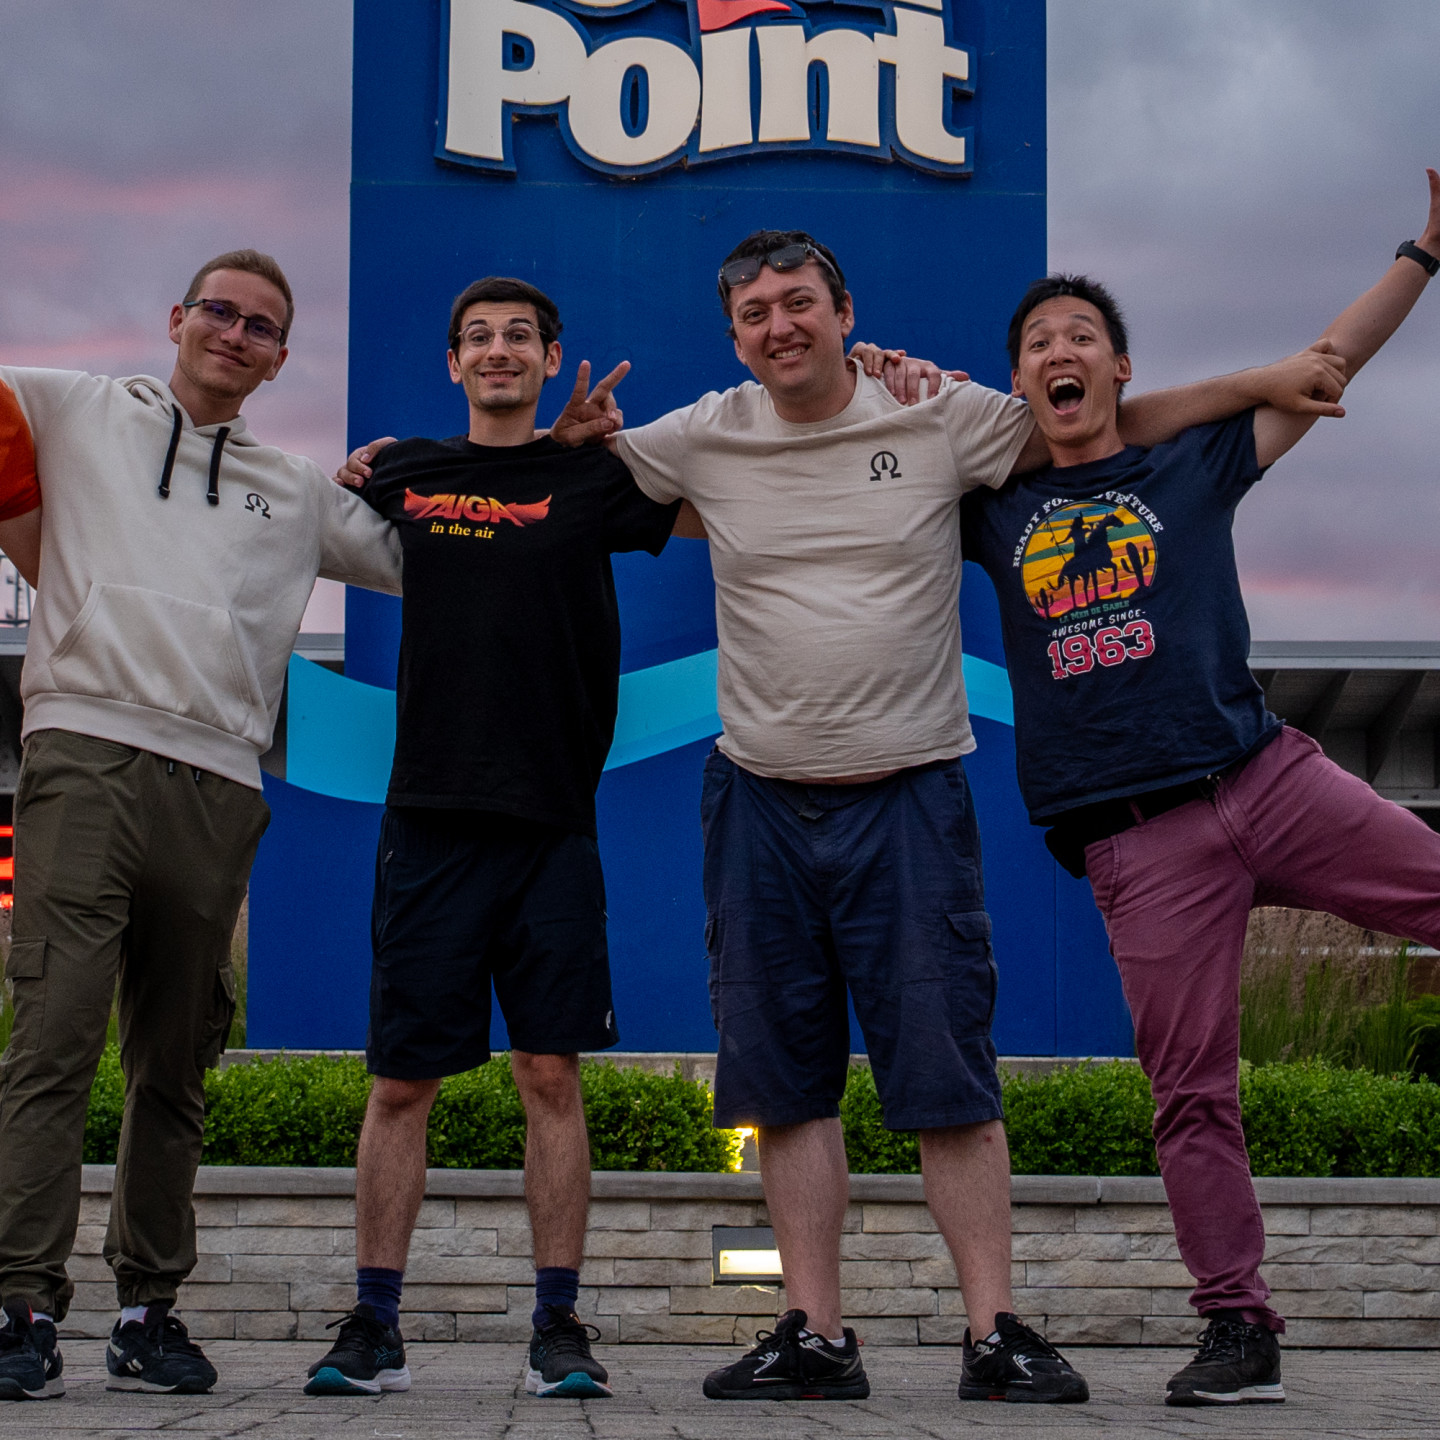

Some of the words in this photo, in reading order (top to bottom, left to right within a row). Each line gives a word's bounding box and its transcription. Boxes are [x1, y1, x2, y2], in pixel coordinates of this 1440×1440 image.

[413, 494, 525, 527] TAIGA
[430, 521, 444, 534] in
[449, 523, 471, 536] the
[474, 526, 495, 539] air
[1013, 512, 1040, 568] READY
[1042, 497, 1074, 514] FO
[1092, 490, 1164, 533] VENTURE
[1047, 619, 1155, 680] 1963
